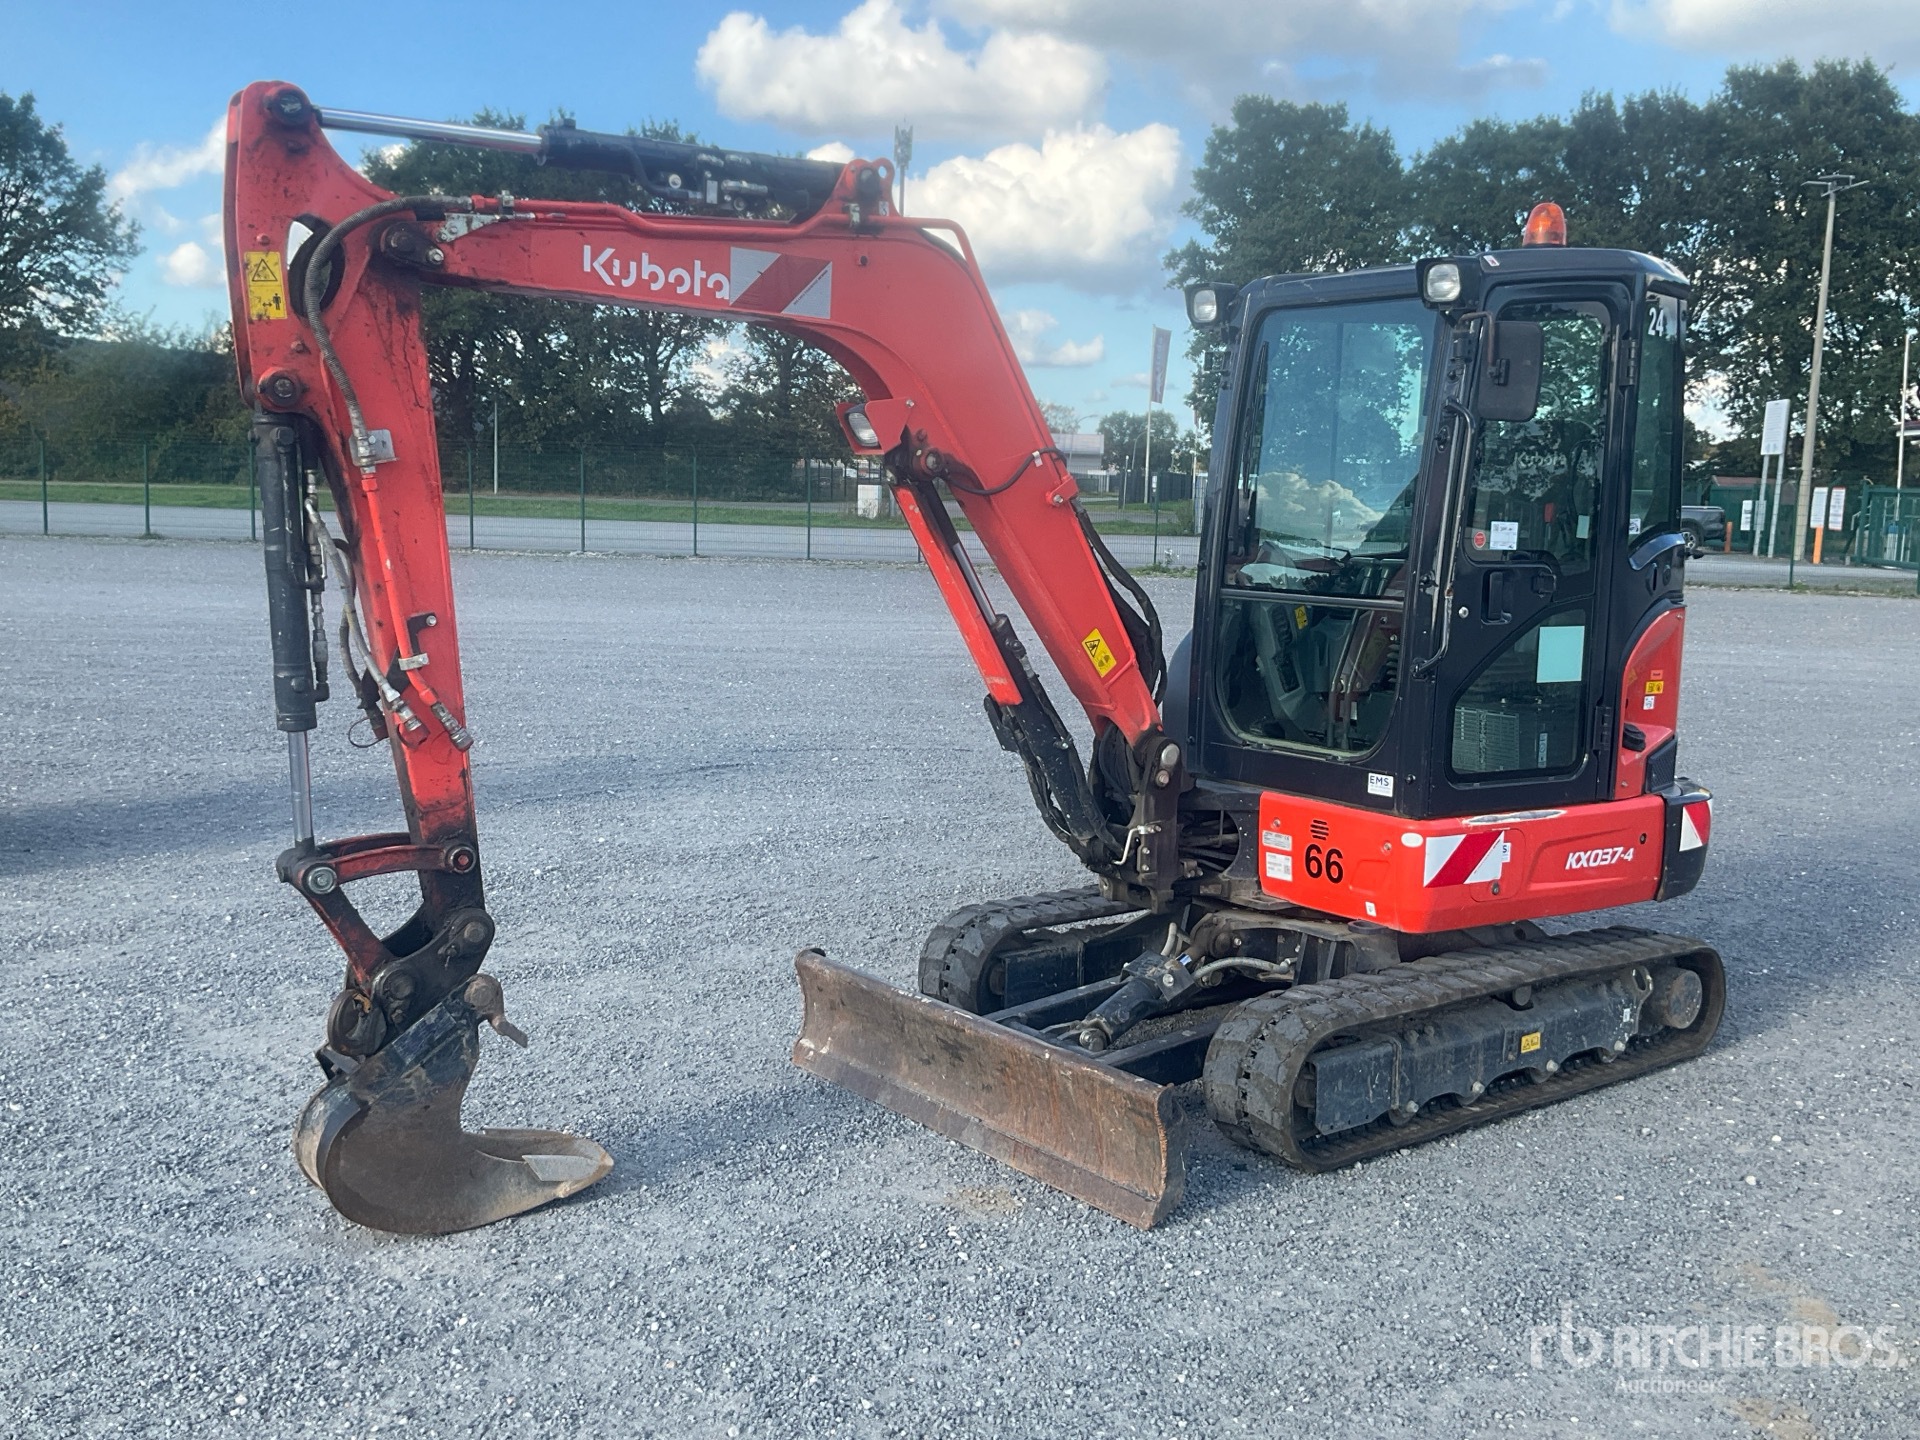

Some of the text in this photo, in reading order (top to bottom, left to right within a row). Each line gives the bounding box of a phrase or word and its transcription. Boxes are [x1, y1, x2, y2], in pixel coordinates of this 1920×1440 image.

[583, 244, 730, 300] Kubota
[1647, 306, 1664, 337] 24
[1369, 775, 1390, 787] EMS
[1304, 843, 1344, 884] 66
[1565, 846, 1635, 870] KX037-4
